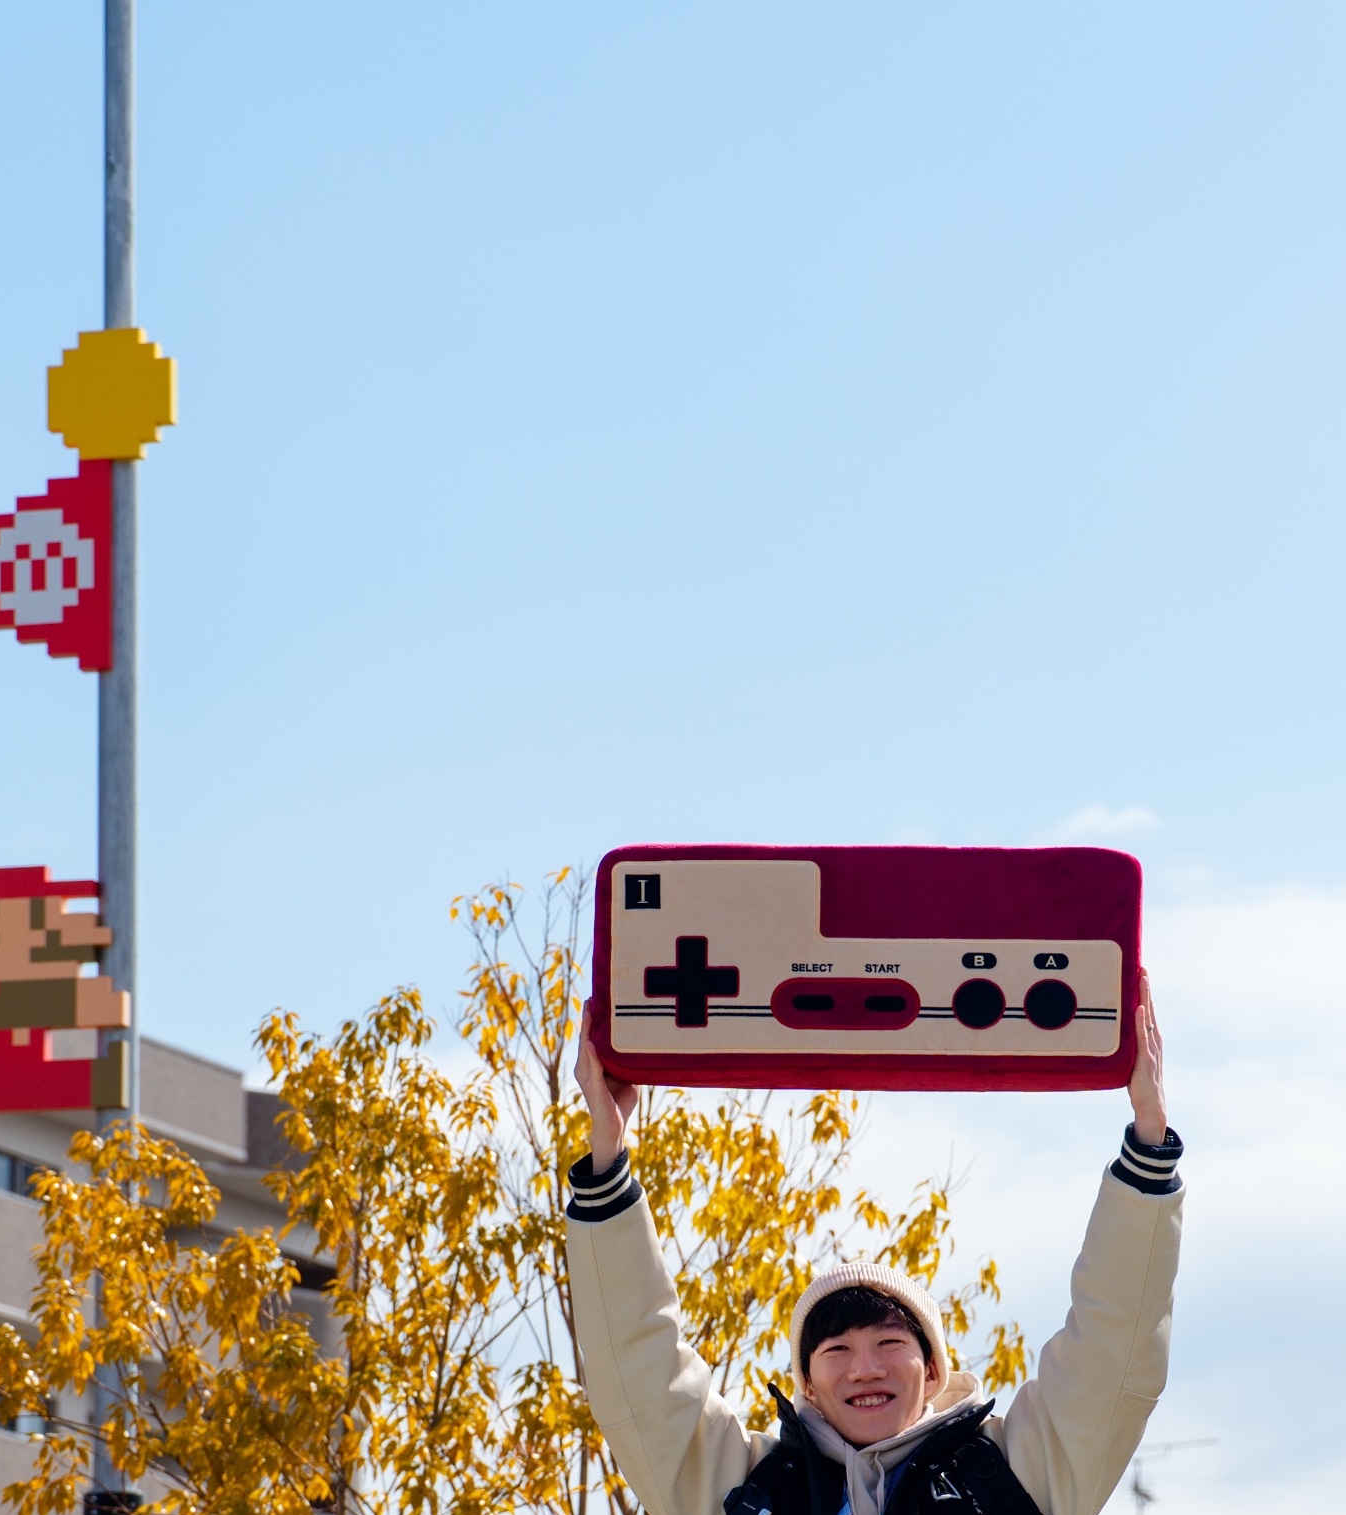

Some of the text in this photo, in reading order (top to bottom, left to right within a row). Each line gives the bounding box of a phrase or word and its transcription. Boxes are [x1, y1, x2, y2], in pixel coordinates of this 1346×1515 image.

[637, 879, 649, 904] I
[973, 955, 986, 967] B
[1044, 955, 1058, 968] A
[790, 962, 834, 973] SELECT
[864, 963, 901, 974] START
